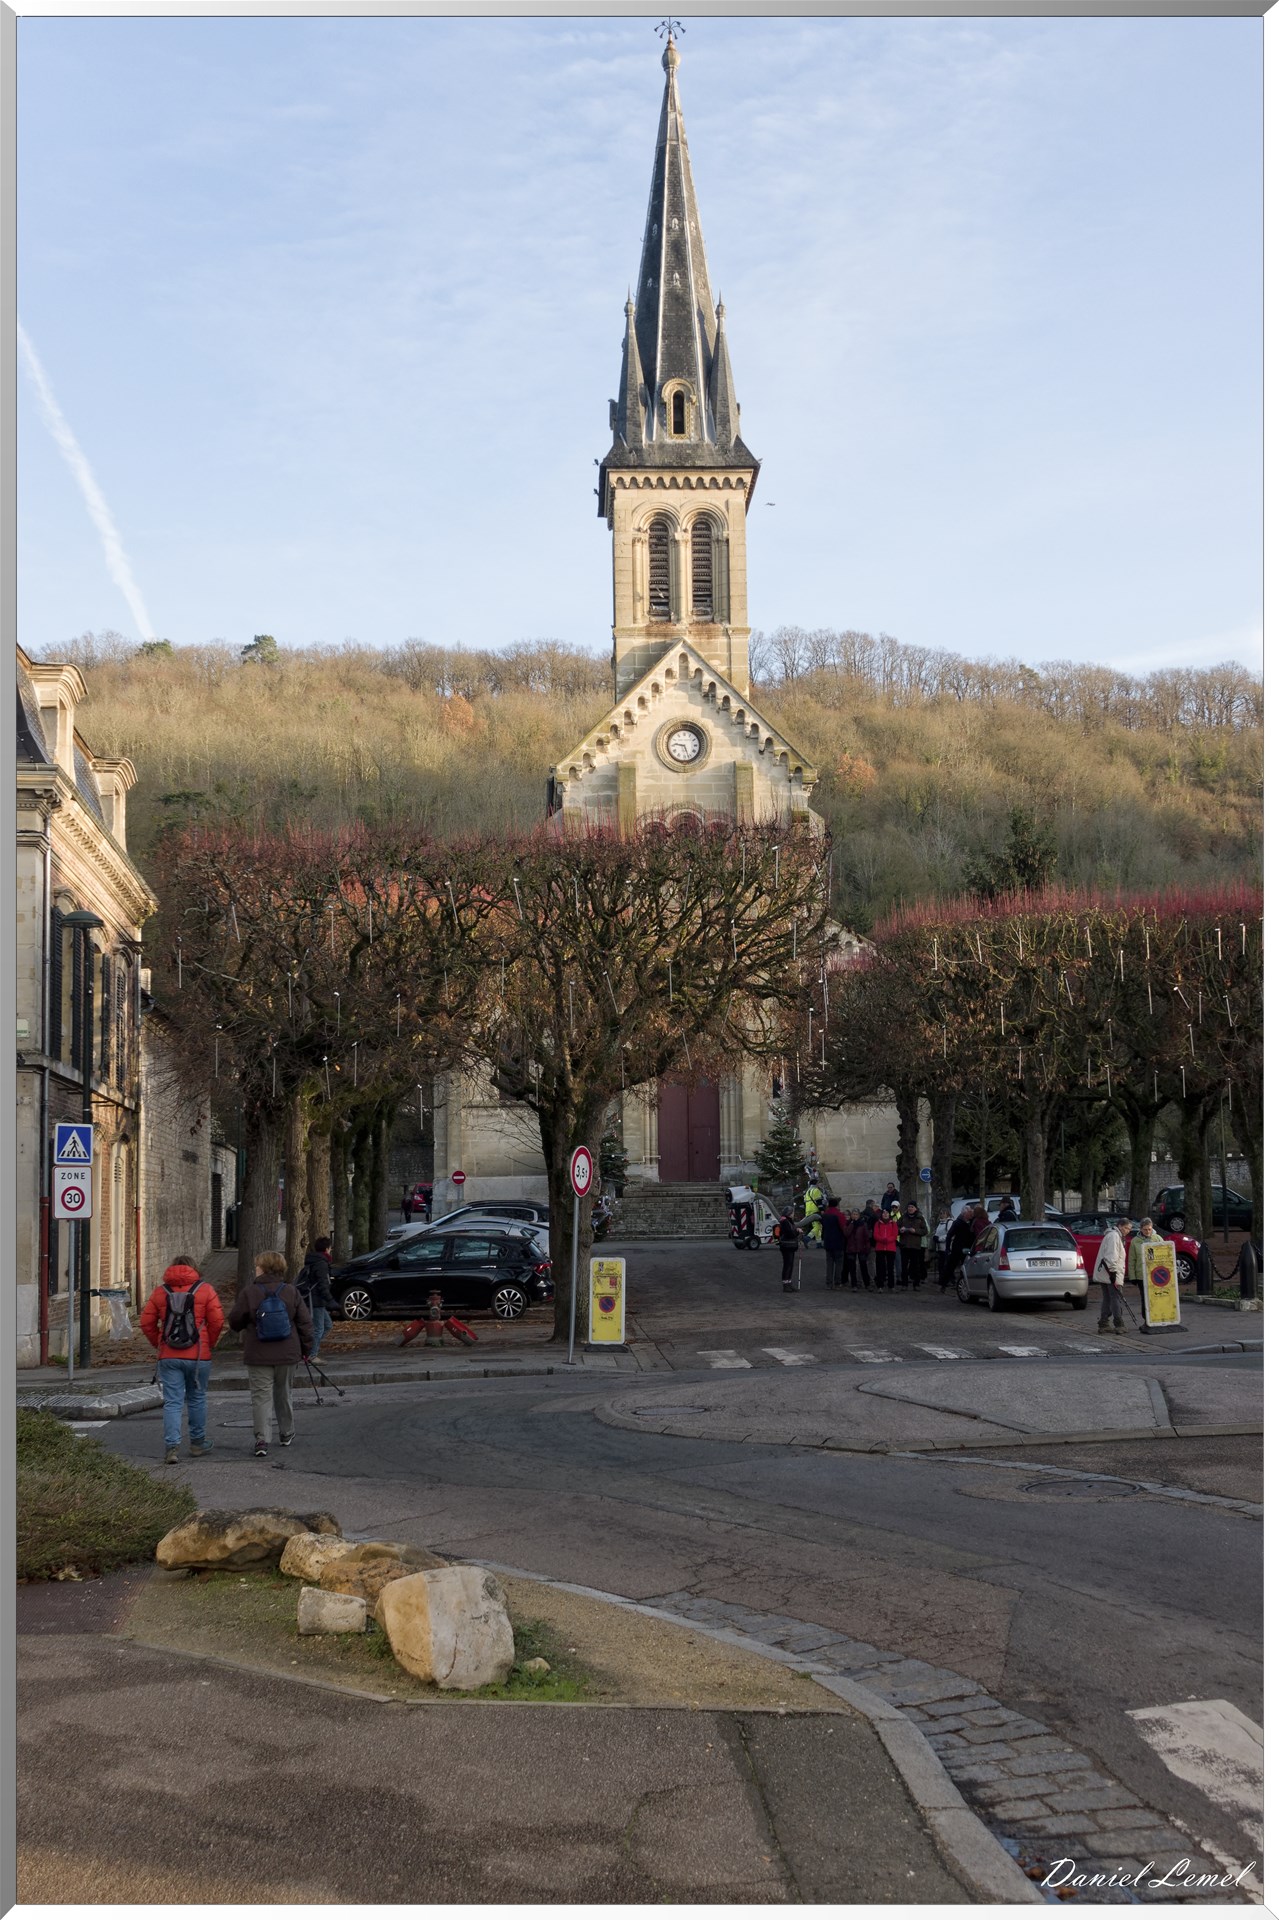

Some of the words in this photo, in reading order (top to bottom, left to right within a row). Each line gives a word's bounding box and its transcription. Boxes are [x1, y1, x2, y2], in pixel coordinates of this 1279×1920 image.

[60, 1172, 86, 1180] ZONE
[576, 1165, 588, 1180] 3,5t
[66, 1192, 81, 1204] 30
